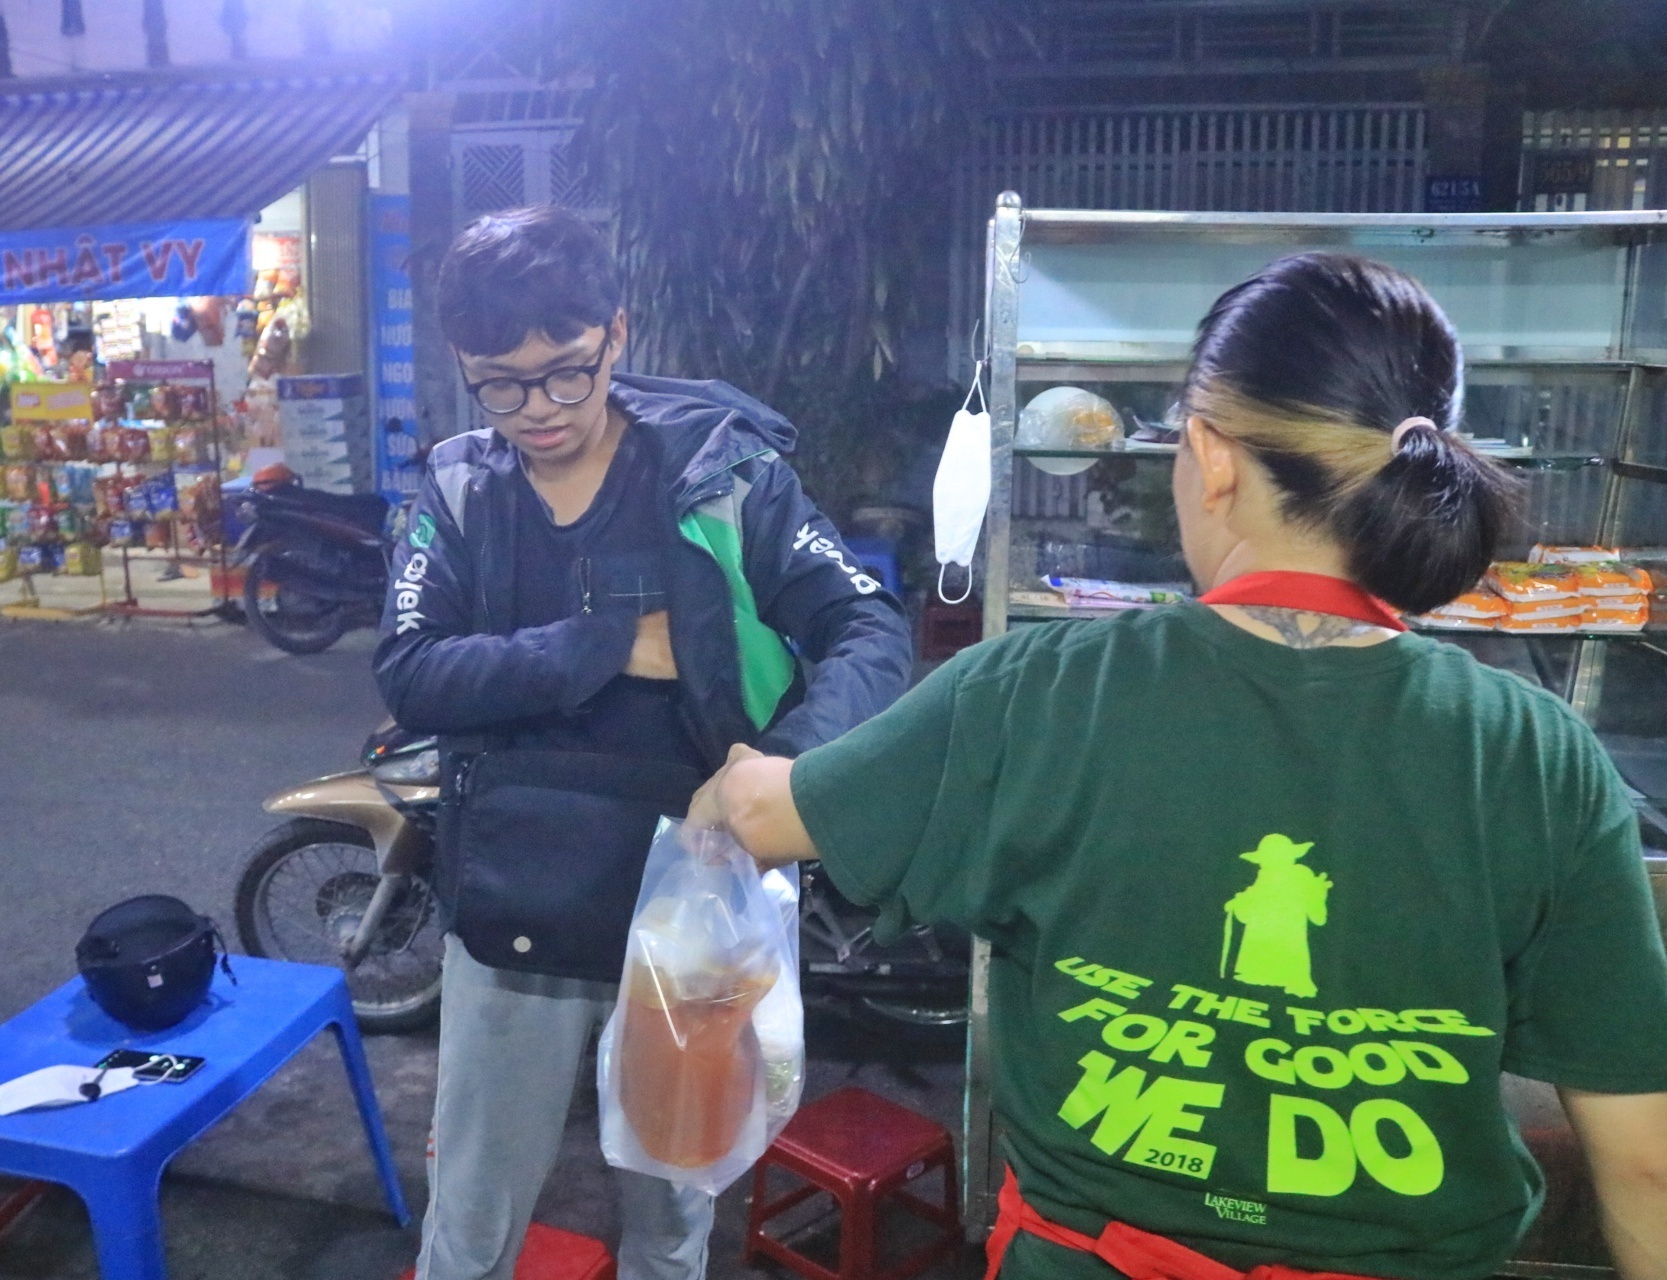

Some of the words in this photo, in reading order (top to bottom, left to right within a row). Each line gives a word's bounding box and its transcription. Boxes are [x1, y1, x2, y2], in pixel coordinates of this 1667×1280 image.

[3, 233, 127, 296] NHẬT
[143, 239, 204, 281] VY
[1054, 956, 1154, 999] USE
[1167, 983, 1271, 1028] THE
[1285, 1006, 1497, 1037] FORCE
[1058, 997, 1216, 1068] FOR
[1244, 1038, 1470, 1090] GOOD
[1057, 1050, 1226, 1180] WE
[1266, 1093, 1445, 1197] DO
[1144, 1148, 1204, 1173] 2018
[1204, 1192, 1267, 1214] LAKEVIEW
[1215, 1205, 1267, 1225] VILLAGE
